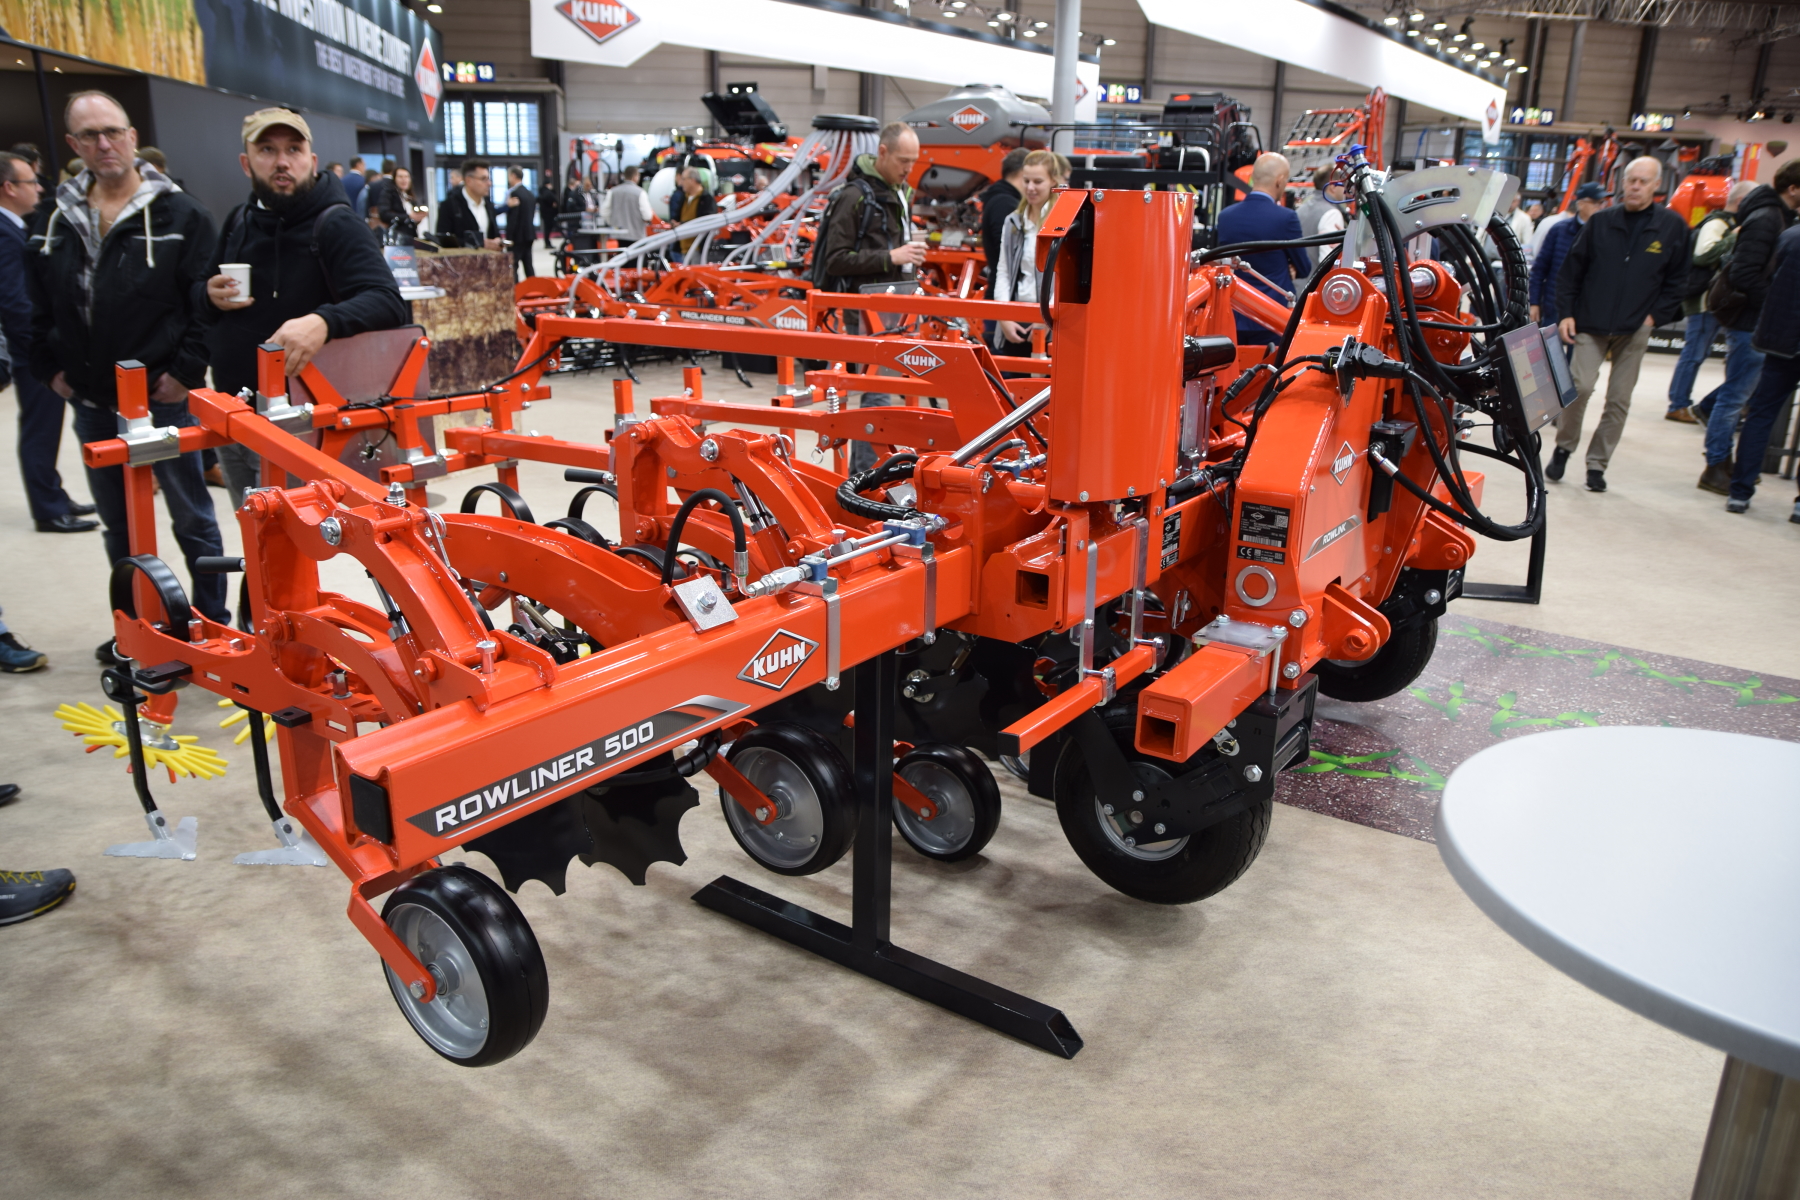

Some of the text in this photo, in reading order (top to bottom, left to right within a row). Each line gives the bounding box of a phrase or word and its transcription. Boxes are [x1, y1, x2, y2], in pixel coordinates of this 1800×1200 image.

[571, 0, 628, 27] KUHN
[1127, 87, 1140, 101] 13
[953, 113, 985, 125] KUHN
[1541, 110, 1554, 124] 13
[681, 310, 725, 323] PROLANDER
[1647, 336, 1670, 348] hine
[903, 354, 936, 367] KUHN
[1333, 453, 1353, 475] KUHN
[1322, 522, 1347, 545] ROWLINK
[753, 641, 806, 680] KUHN
[435, 721, 654, 832] ROWLINER 500
